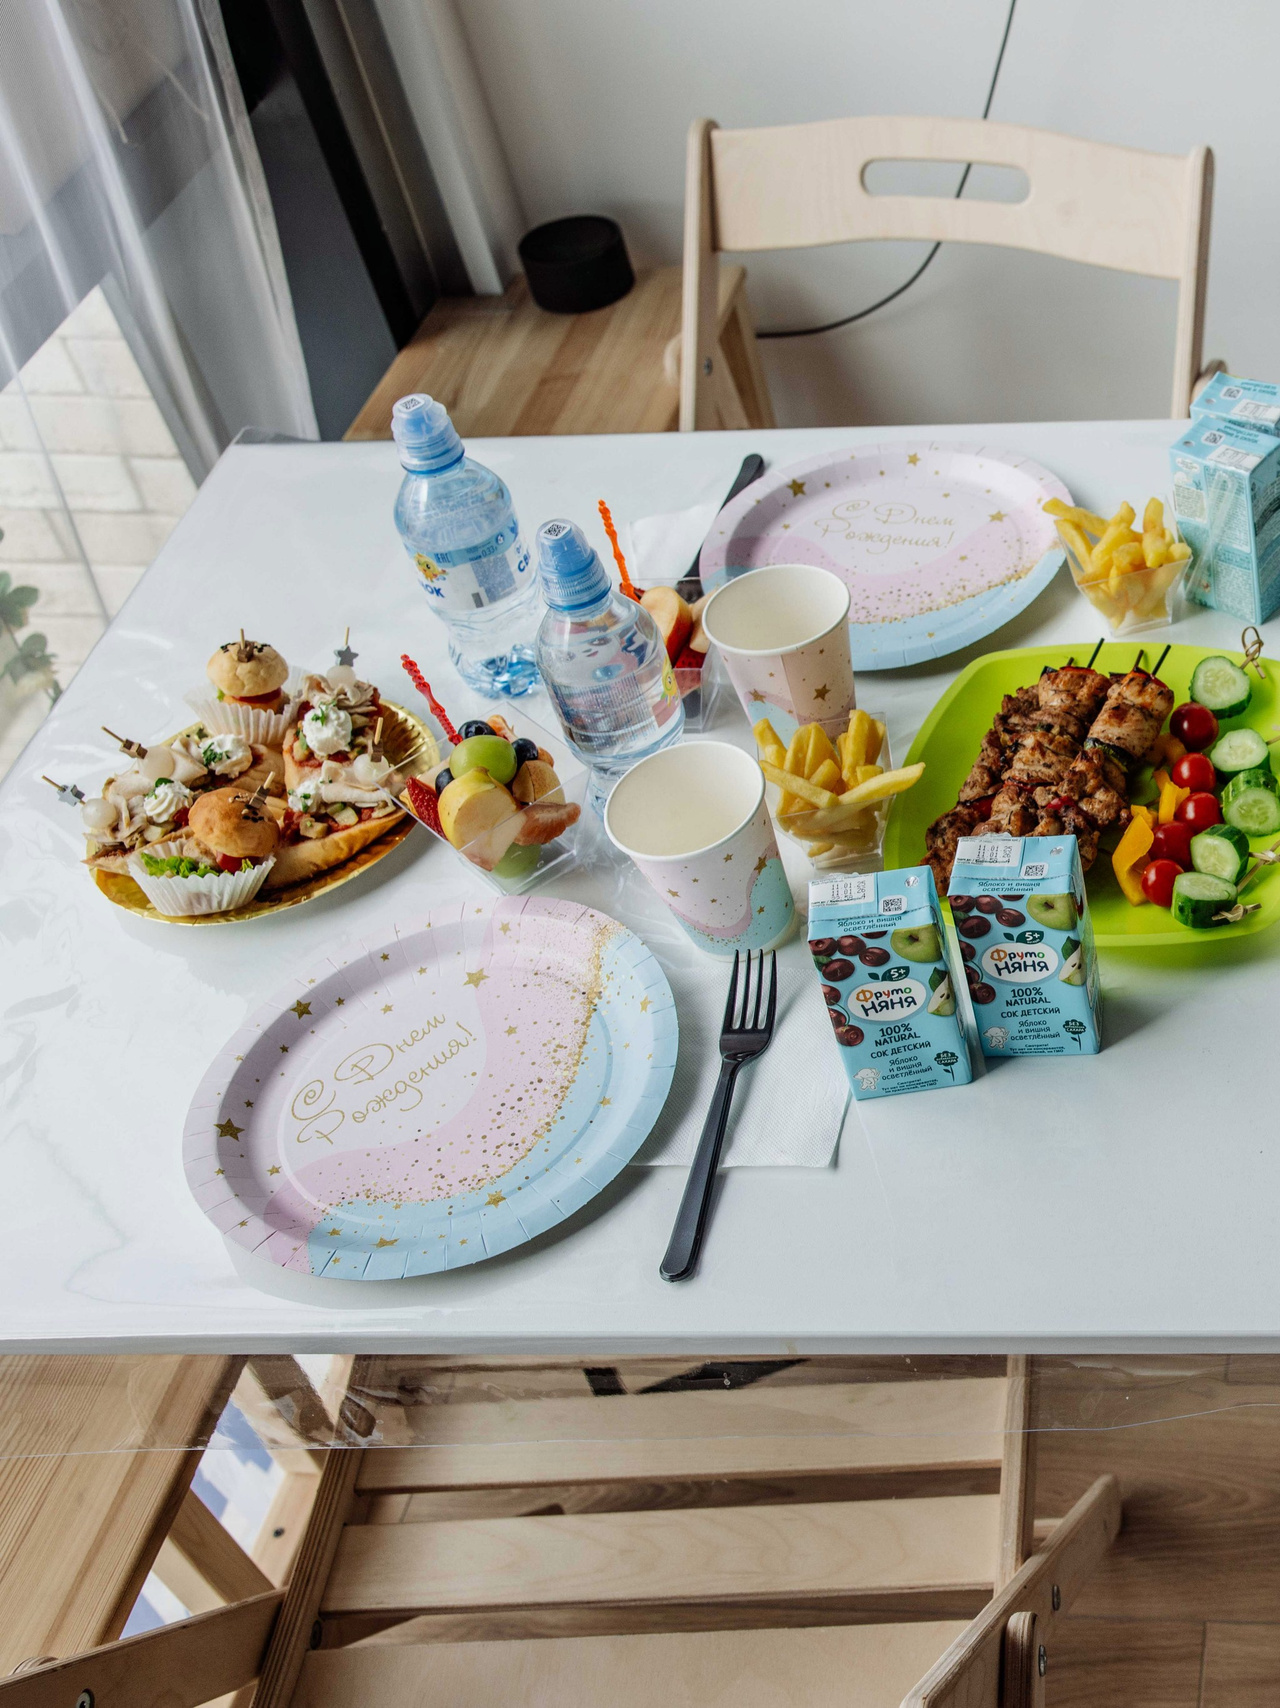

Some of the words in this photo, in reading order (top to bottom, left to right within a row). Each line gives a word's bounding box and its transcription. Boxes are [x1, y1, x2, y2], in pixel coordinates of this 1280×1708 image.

[874, 502, 955, 526] Днем
[814, 517, 955, 555] Рождения!
[837, 919, 866, 928] Яблоко
[1025, 932, 1040, 941] 5+
[890, 968, 906, 978] 5+
[1010, 987, 1043, 998] 100%
[1006, 997, 1051, 1007] NATURAL
[1001, 1010, 1018, 1018] СОК
[1021, 1007, 1060, 1017] ДЕТСКИЙ
[1019, 1020, 1047, 1028] Яблоко
[879, 1023, 912, 1037] 100%
[874, 1031, 921, 1047] NATURAL
[1011, 1032, 1060, 1041] осветлённый
[870, 1049, 888, 1059] СОК
[891, 1040, 931, 1056] ДЕТСКИЙ
[889, 1056, 918, 1067] Яблоко
[896, 1062, 922, 1071] вишня
[291, 1079, 336, 1121] С
[334, 1014, 446, 1085] Днем
[882, 1066, 933, 1081] осветлённый
[296, 1021, 478, 1145] Рождения!
